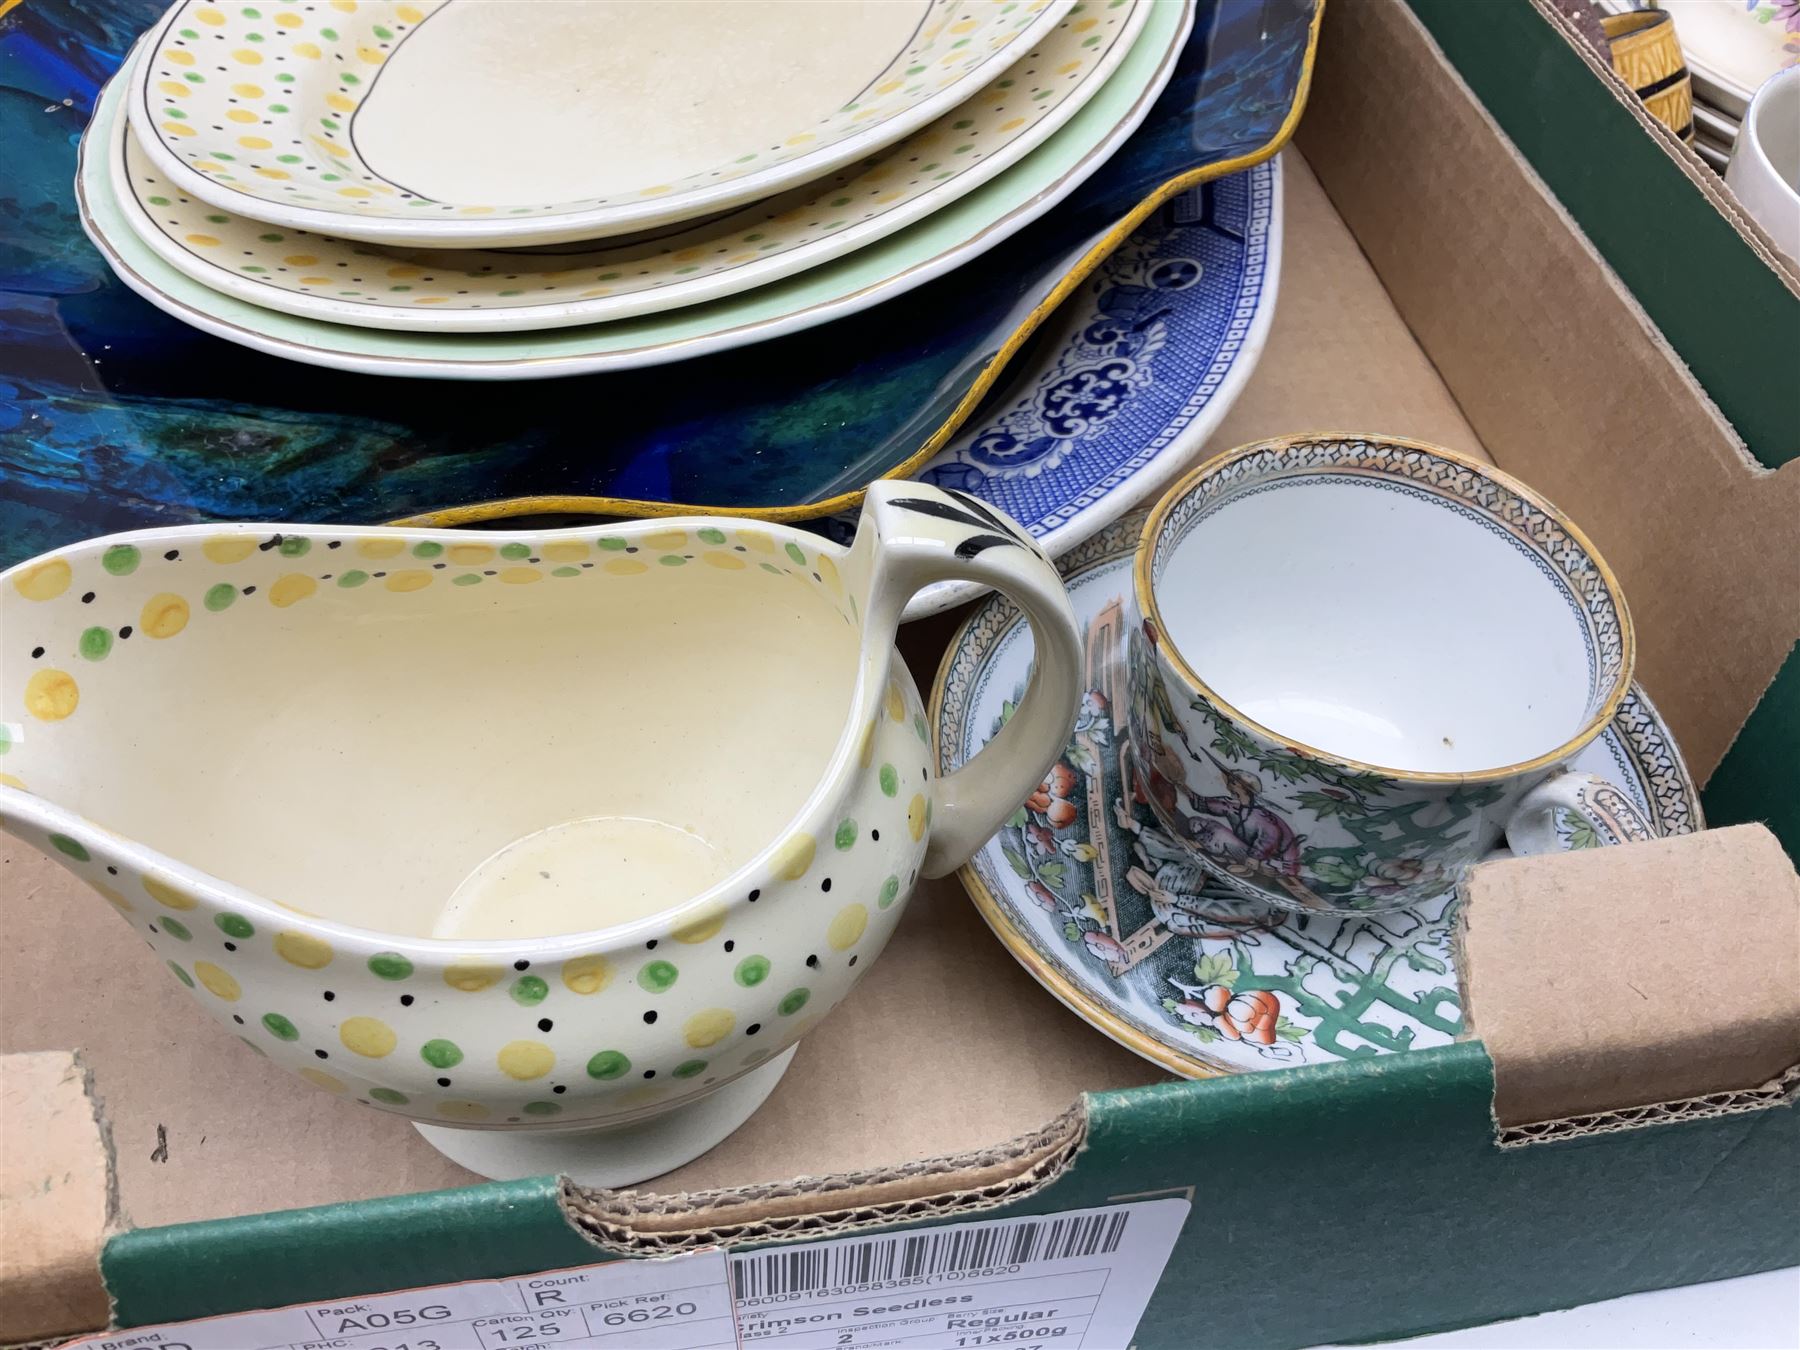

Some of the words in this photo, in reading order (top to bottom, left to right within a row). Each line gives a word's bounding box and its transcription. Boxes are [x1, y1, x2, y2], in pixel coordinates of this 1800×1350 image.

[535, 1290, 567, 1306] R
[591, 1300, 628, 1312] Pick
[853, 1295, 973, 1317] Seedless
[317, 1304, 372, 1317] Pack:
[338, 1305, 452, 1333] A05G
[603, 1302, 698, 1326] 6620
[947, 1309, 1058, 1330] Regular
[473, 1315, 534, 1327] Carton
[837, 1322, 896, 1334] Inspection
[900, 1317, 936, 1326] Group
[491, 1322, 561, 1341] 125
[837, 1334, 853, 1344] 2
[955, 1326, 1068, 1346] 11x500g
